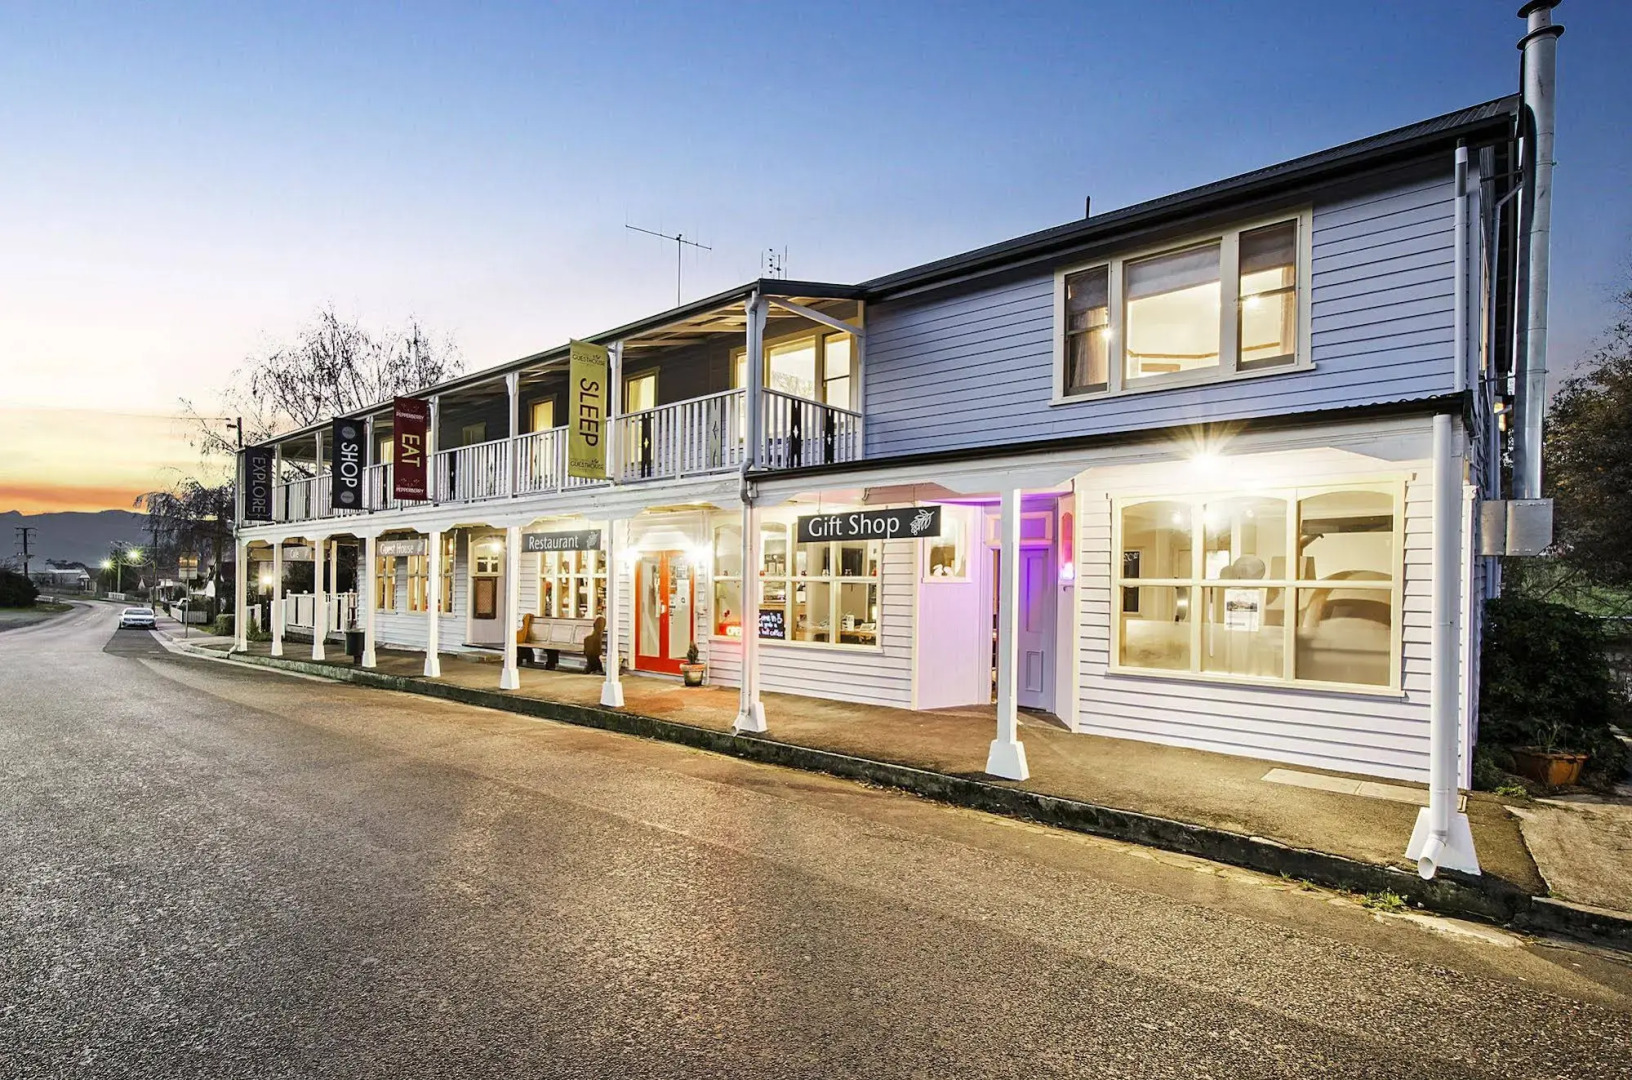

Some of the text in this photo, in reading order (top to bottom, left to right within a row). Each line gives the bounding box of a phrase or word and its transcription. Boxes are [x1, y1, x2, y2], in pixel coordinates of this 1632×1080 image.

[579, 377, 600, 447] SLEEP
[401, 433, 420, 468] EAT
[340, 442, 359, 488] SHOP
[808, 513, 900, 539] Gift Shop
[379, 542, 414, 555] Guest House
[528, 535, 579, 550] Restaurant
[726, 625, 741, 637] OPE
